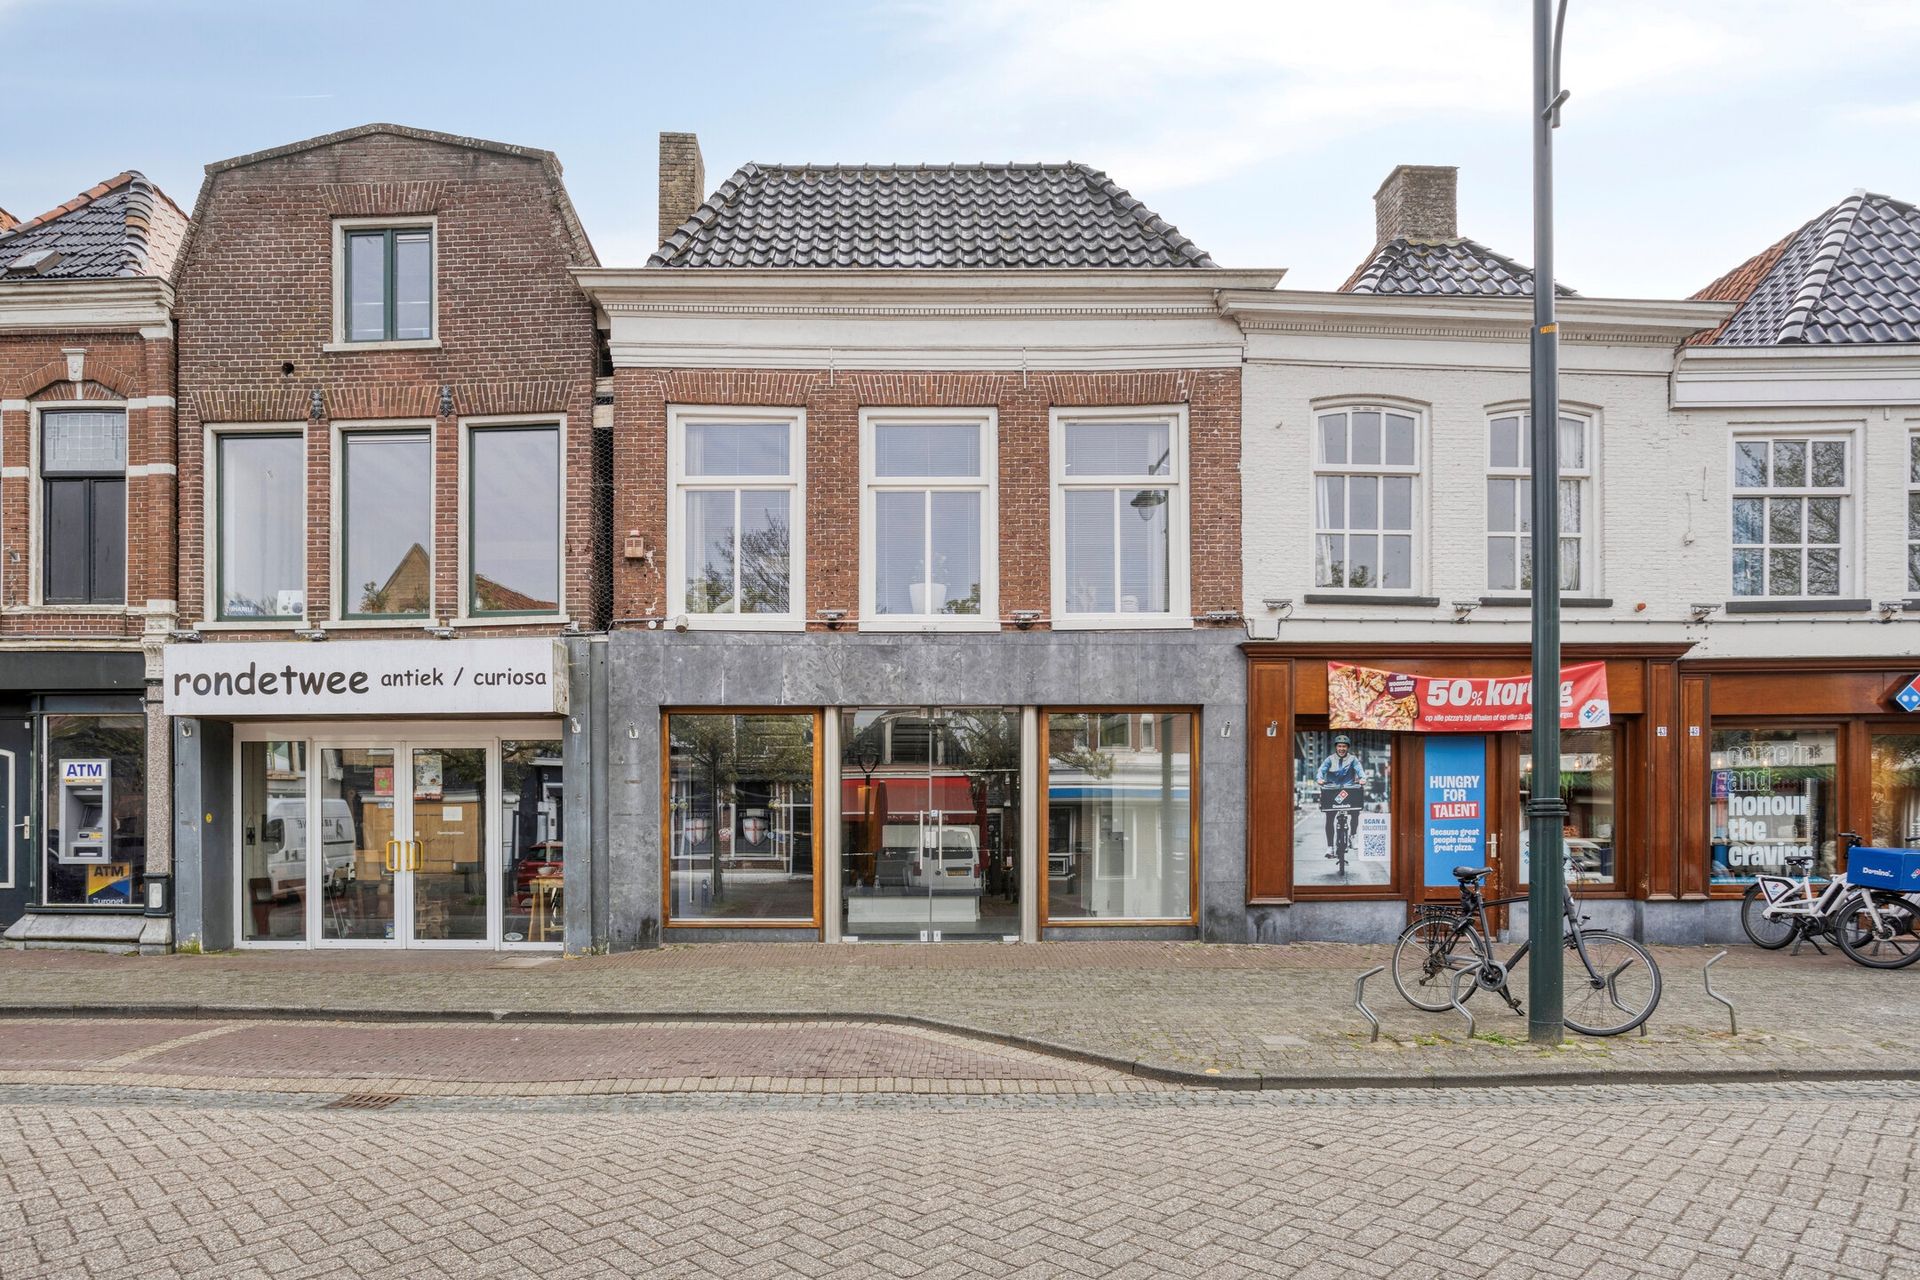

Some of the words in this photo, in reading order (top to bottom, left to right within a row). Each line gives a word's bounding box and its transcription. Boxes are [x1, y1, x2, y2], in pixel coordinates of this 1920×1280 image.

[174, 661, 369, 697] rondetwee
[380, 667, 444, 687] antiek
[453, 666, 464, 687] /
[473, 667, 547, 686] curiosa
[1425, 714, 1433, 722] op
[1433, 713, 1444, 722] alle
[1444, 713, 1464, 723] pizza's
[1464, 713, 1472, 722] bij
[1472, 713, 1492, 721] afhalen
[1493, 713, 1500, 721] of
[1727, 744, 1789, 767] come
[1792, 741, 1816, 767] in
[66, 764, 102, 777] ATM
[1430, 775, 1479, 789] HUNGRY
[1727, 767, 1771, 792] and
[1443, 789, 1466, 802] FOR
[1433, 803, 1477, 818] TALENT
[1728, 793, 1810, 817] honour
[1430, 828, 1459, 836] Because
[1460, 828, 1480, 837] great
[1727, 818, 1767, 841] the
[1433, 837, 1457, 845] people
[1458, 836, 1477, 844] make
[1433, 845, 1454, 854] great
[1455, 844, 1474, 853] pizza.
[93, 866, 124, 877] ATM
